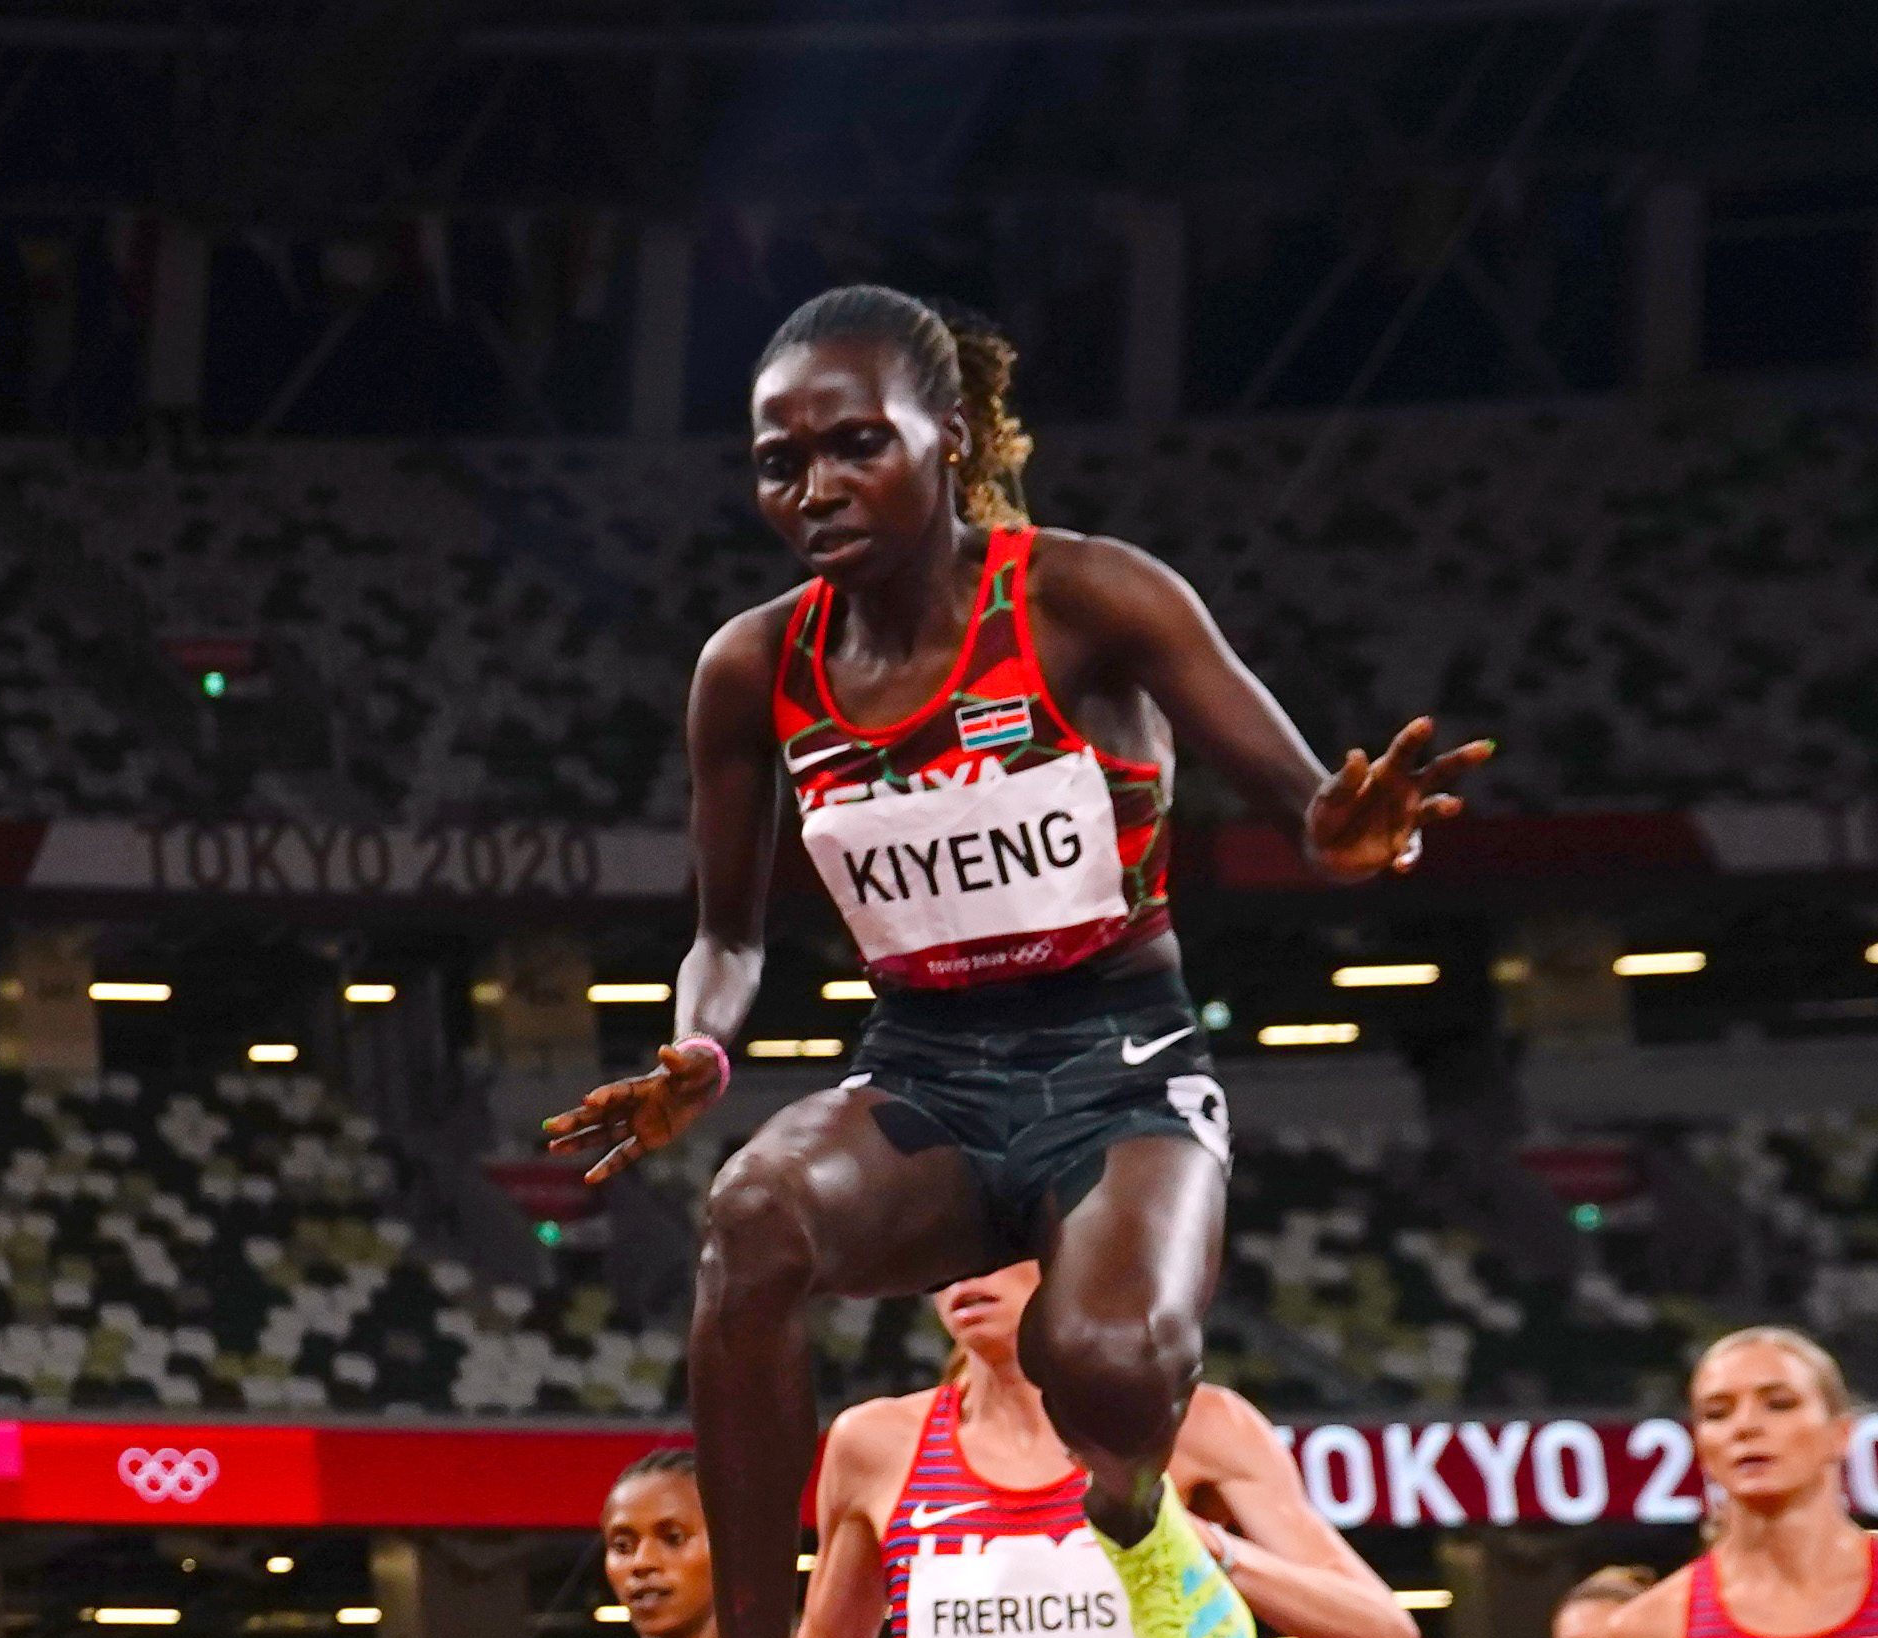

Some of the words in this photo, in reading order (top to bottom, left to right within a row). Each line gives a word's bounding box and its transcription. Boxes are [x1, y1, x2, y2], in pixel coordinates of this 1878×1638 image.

[137, 812, 392, 898] TOKYO
[413, 817, 600, 898] 2020
[843, 811, 1083, 905] KIYENG
[1273, 1419, 1612, 1528] OKYO
[933, 1593, 1117, 1636] FRERICHS
